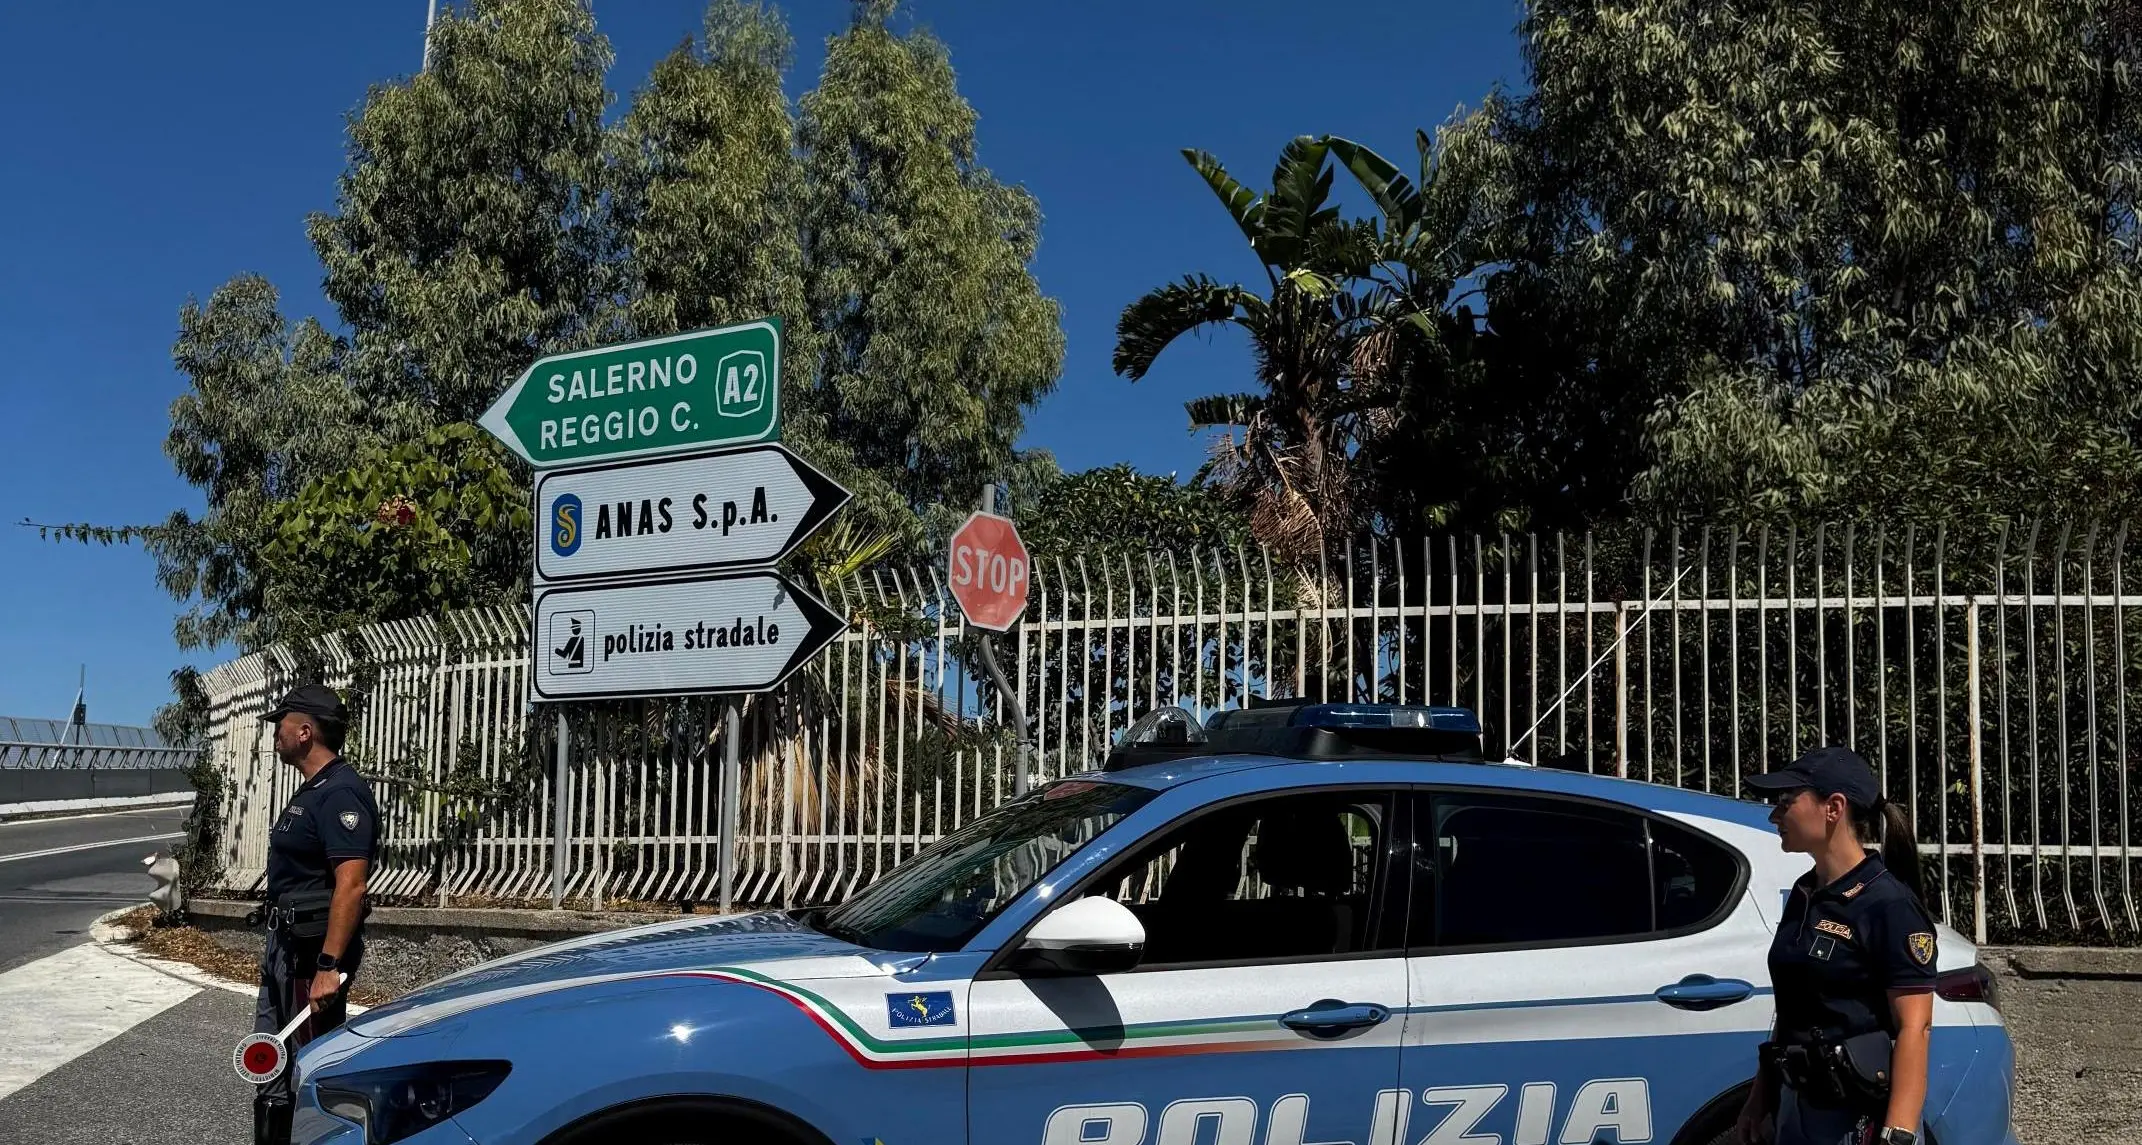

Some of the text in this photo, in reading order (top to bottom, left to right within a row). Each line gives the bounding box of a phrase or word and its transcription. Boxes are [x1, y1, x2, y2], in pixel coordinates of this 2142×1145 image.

[548, 353, 697, 403] SALERNO
[723, 364, 758, 405] A2
[540, 402, 699, 450] REGGIO C.
[595, 486, 778, 539] ANAS S.p.A.
[956, 545, 1024, 597] STOP
[604, 616, 779, 662] polizia stradale
[1041, 1077, 1654, 1145] POLIZIA
